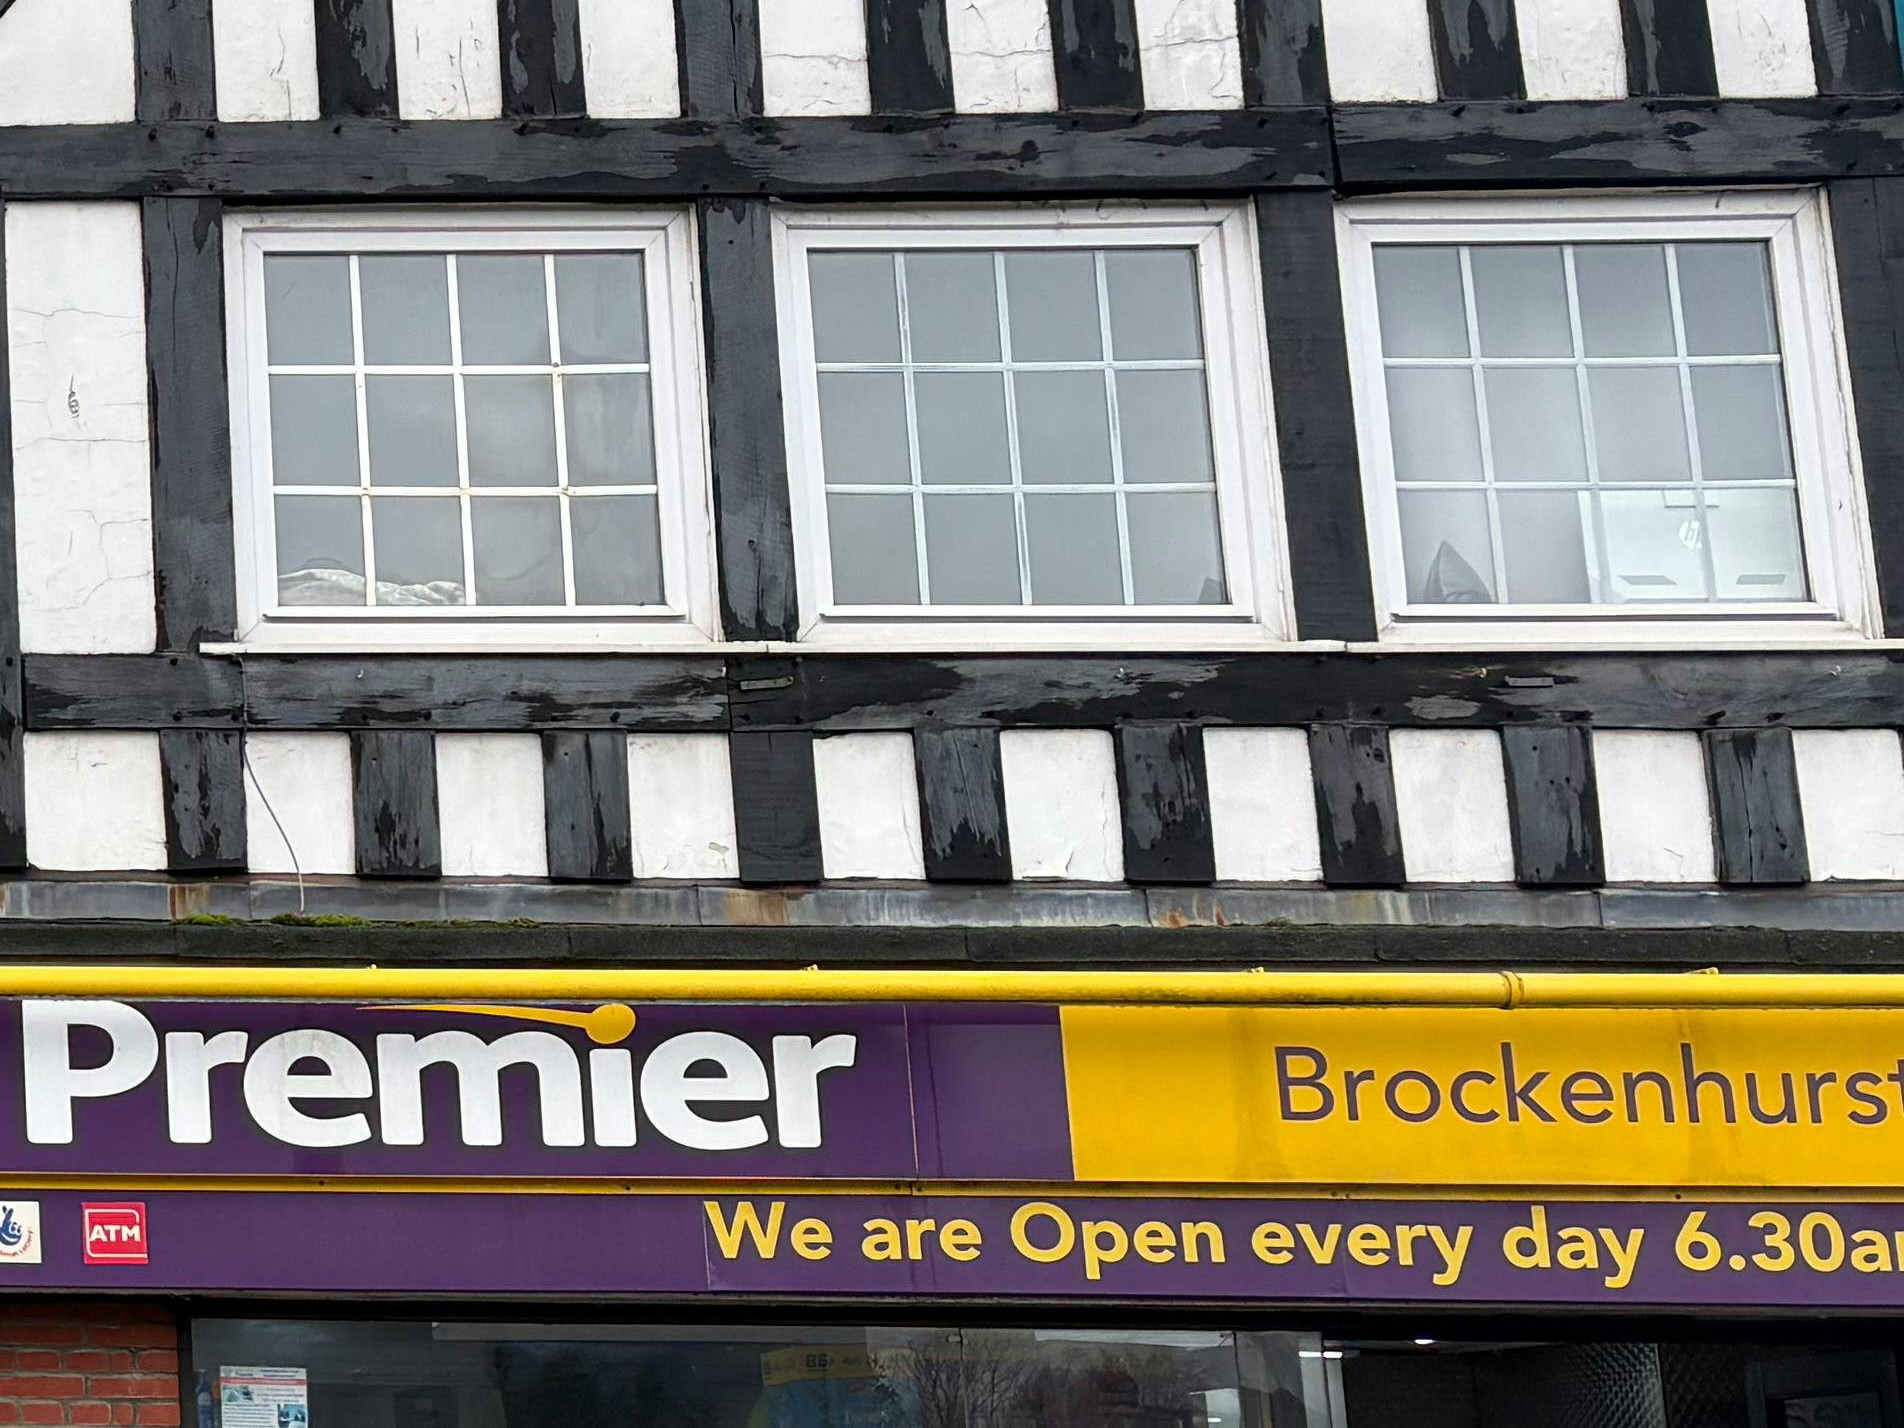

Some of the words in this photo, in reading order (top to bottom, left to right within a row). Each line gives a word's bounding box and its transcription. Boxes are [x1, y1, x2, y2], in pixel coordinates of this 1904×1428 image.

[21, 999, 857, 1151] Premier
[89, 1224, 142, 1243] ATM
[704, 1201, 833, 1260] We
[863, 1217, 982, 1261] are
[1010, 1201, 1226, 1280] Open
[1252, 1220, 1473, 1286] every
[1502, 1209, 1645, 1288] day
[1674, 1211, 1904, 1273] 6.30a
